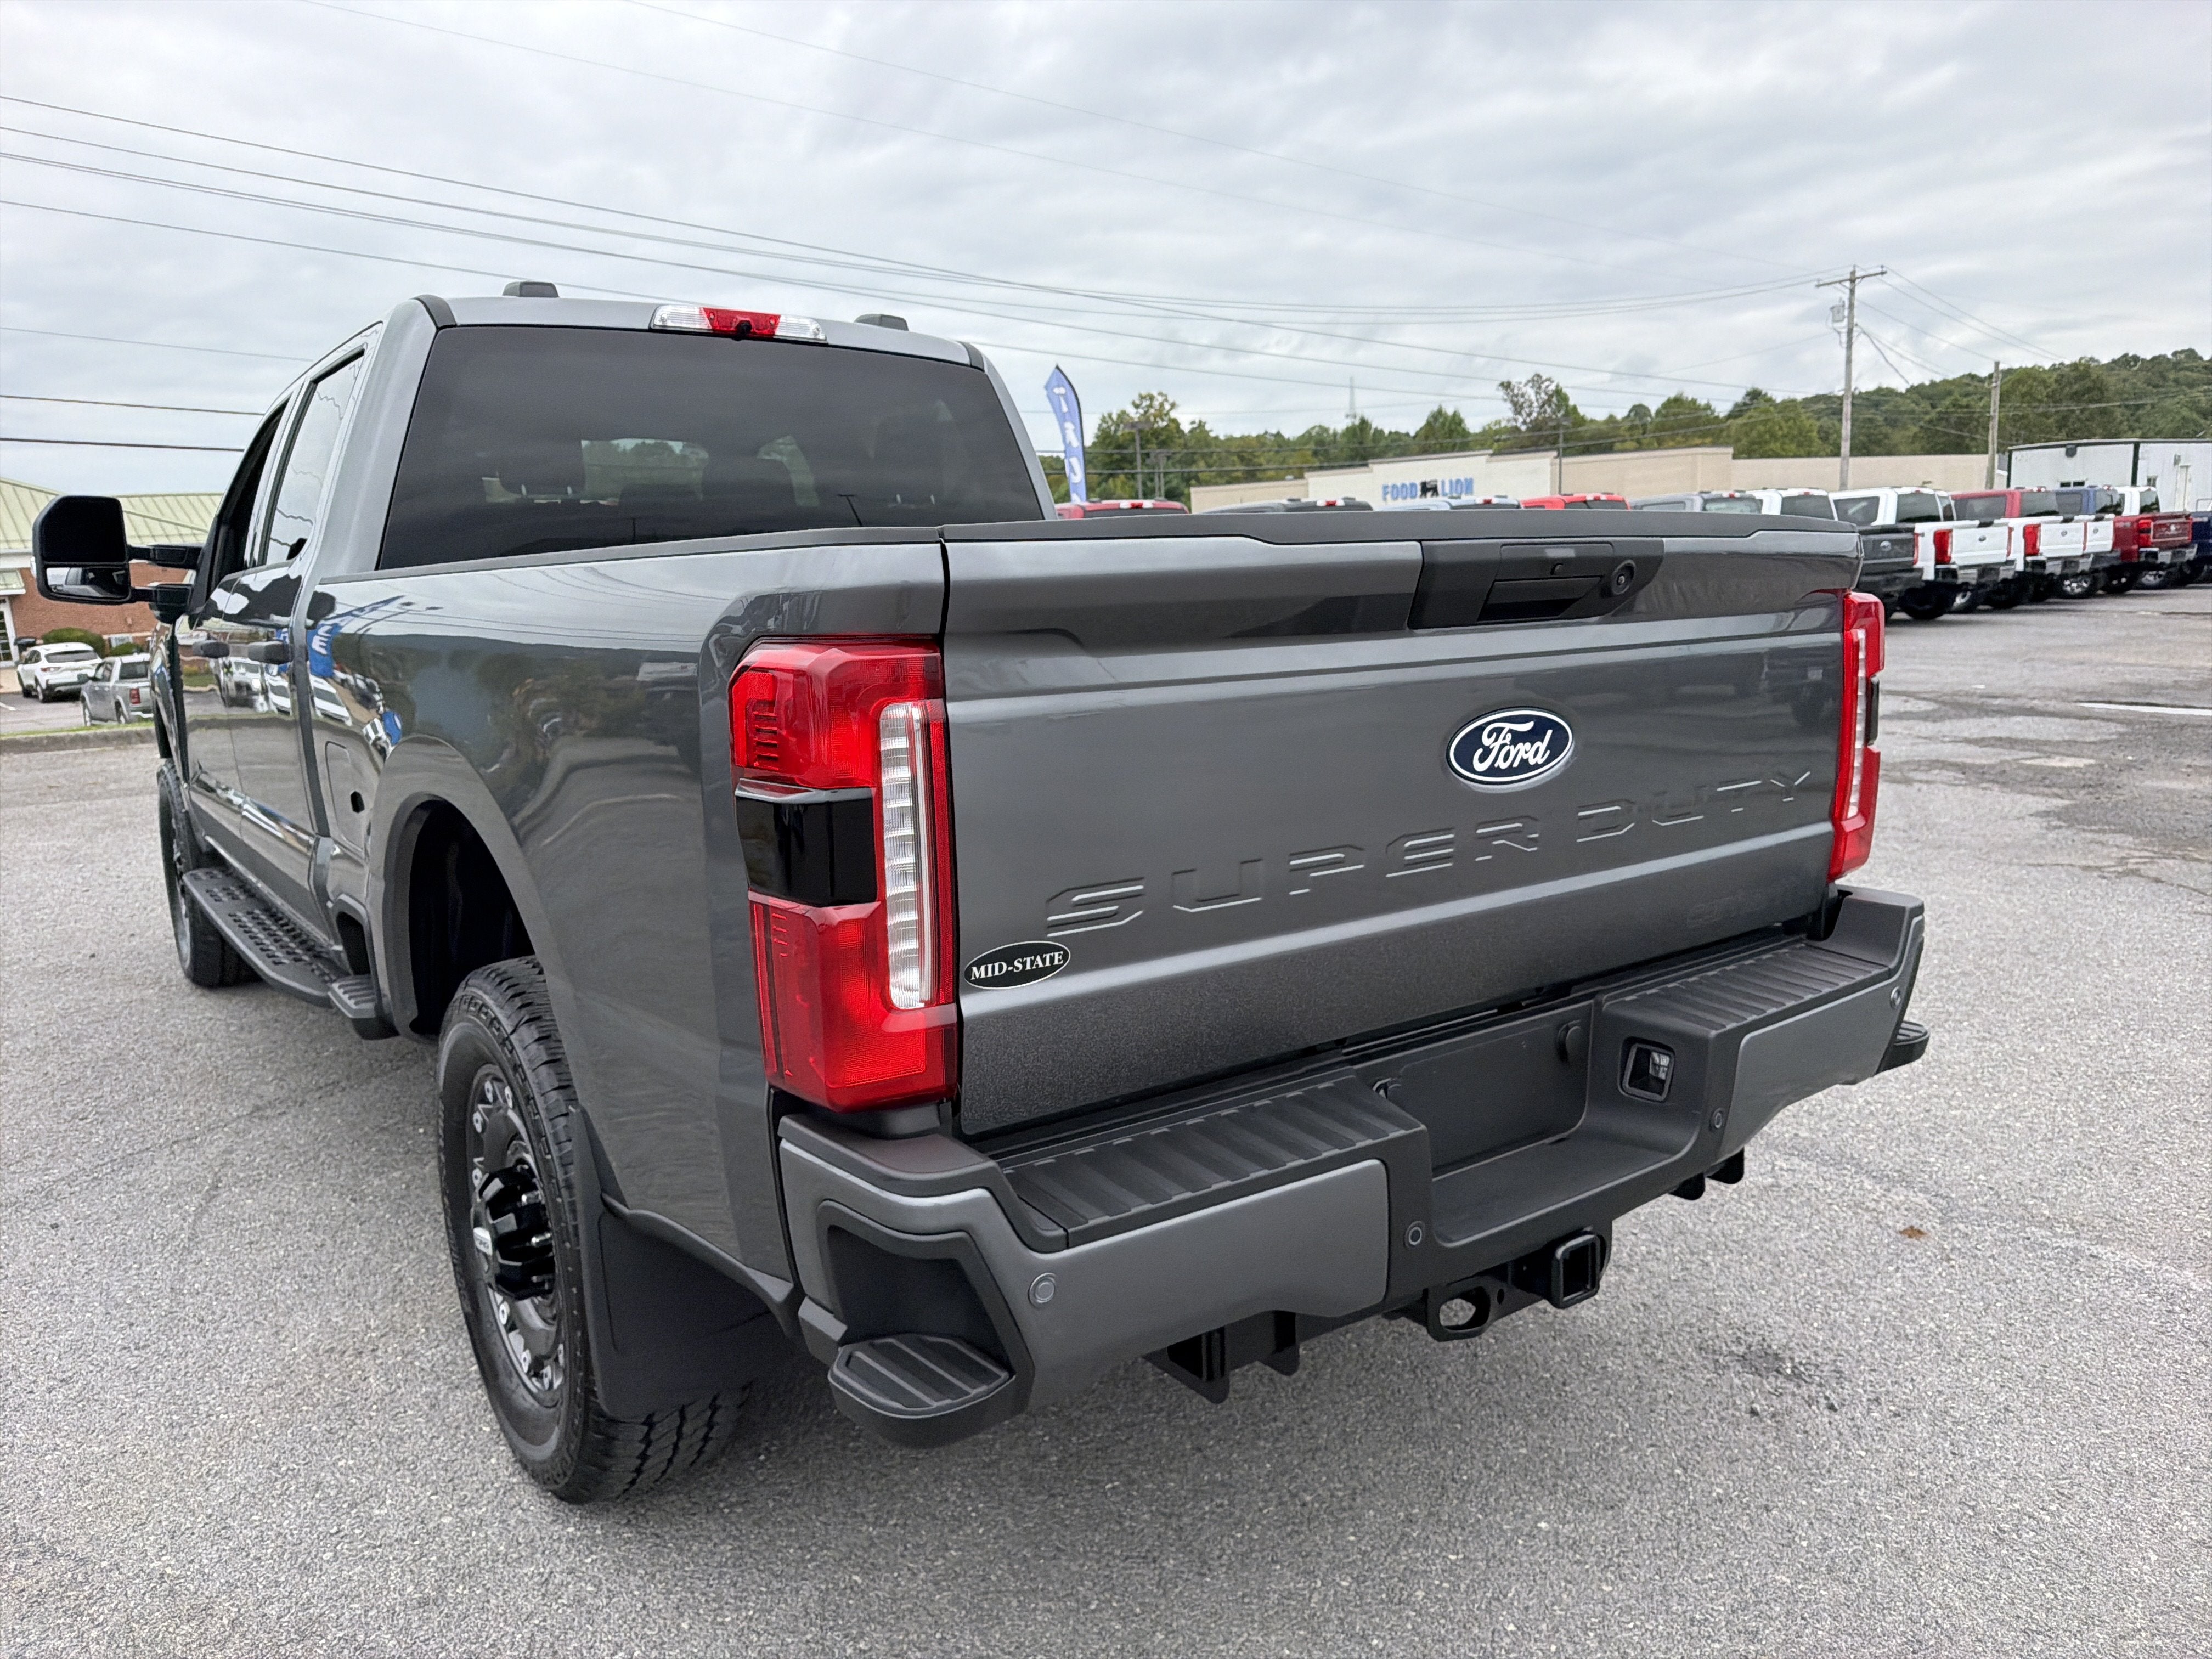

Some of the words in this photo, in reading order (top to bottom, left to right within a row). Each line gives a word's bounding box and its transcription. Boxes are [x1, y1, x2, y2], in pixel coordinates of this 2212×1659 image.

[1382, 482, 1418, 501] FOOD
[1441, 477, 1475, 496] LION
[1472, 720, 1553, 772] Ford
[1046, 815, 1539, 938] SUPER
[1576, 769, 1812, 843] DUTY
[970, 951, 1064, 980] MID-STATE
